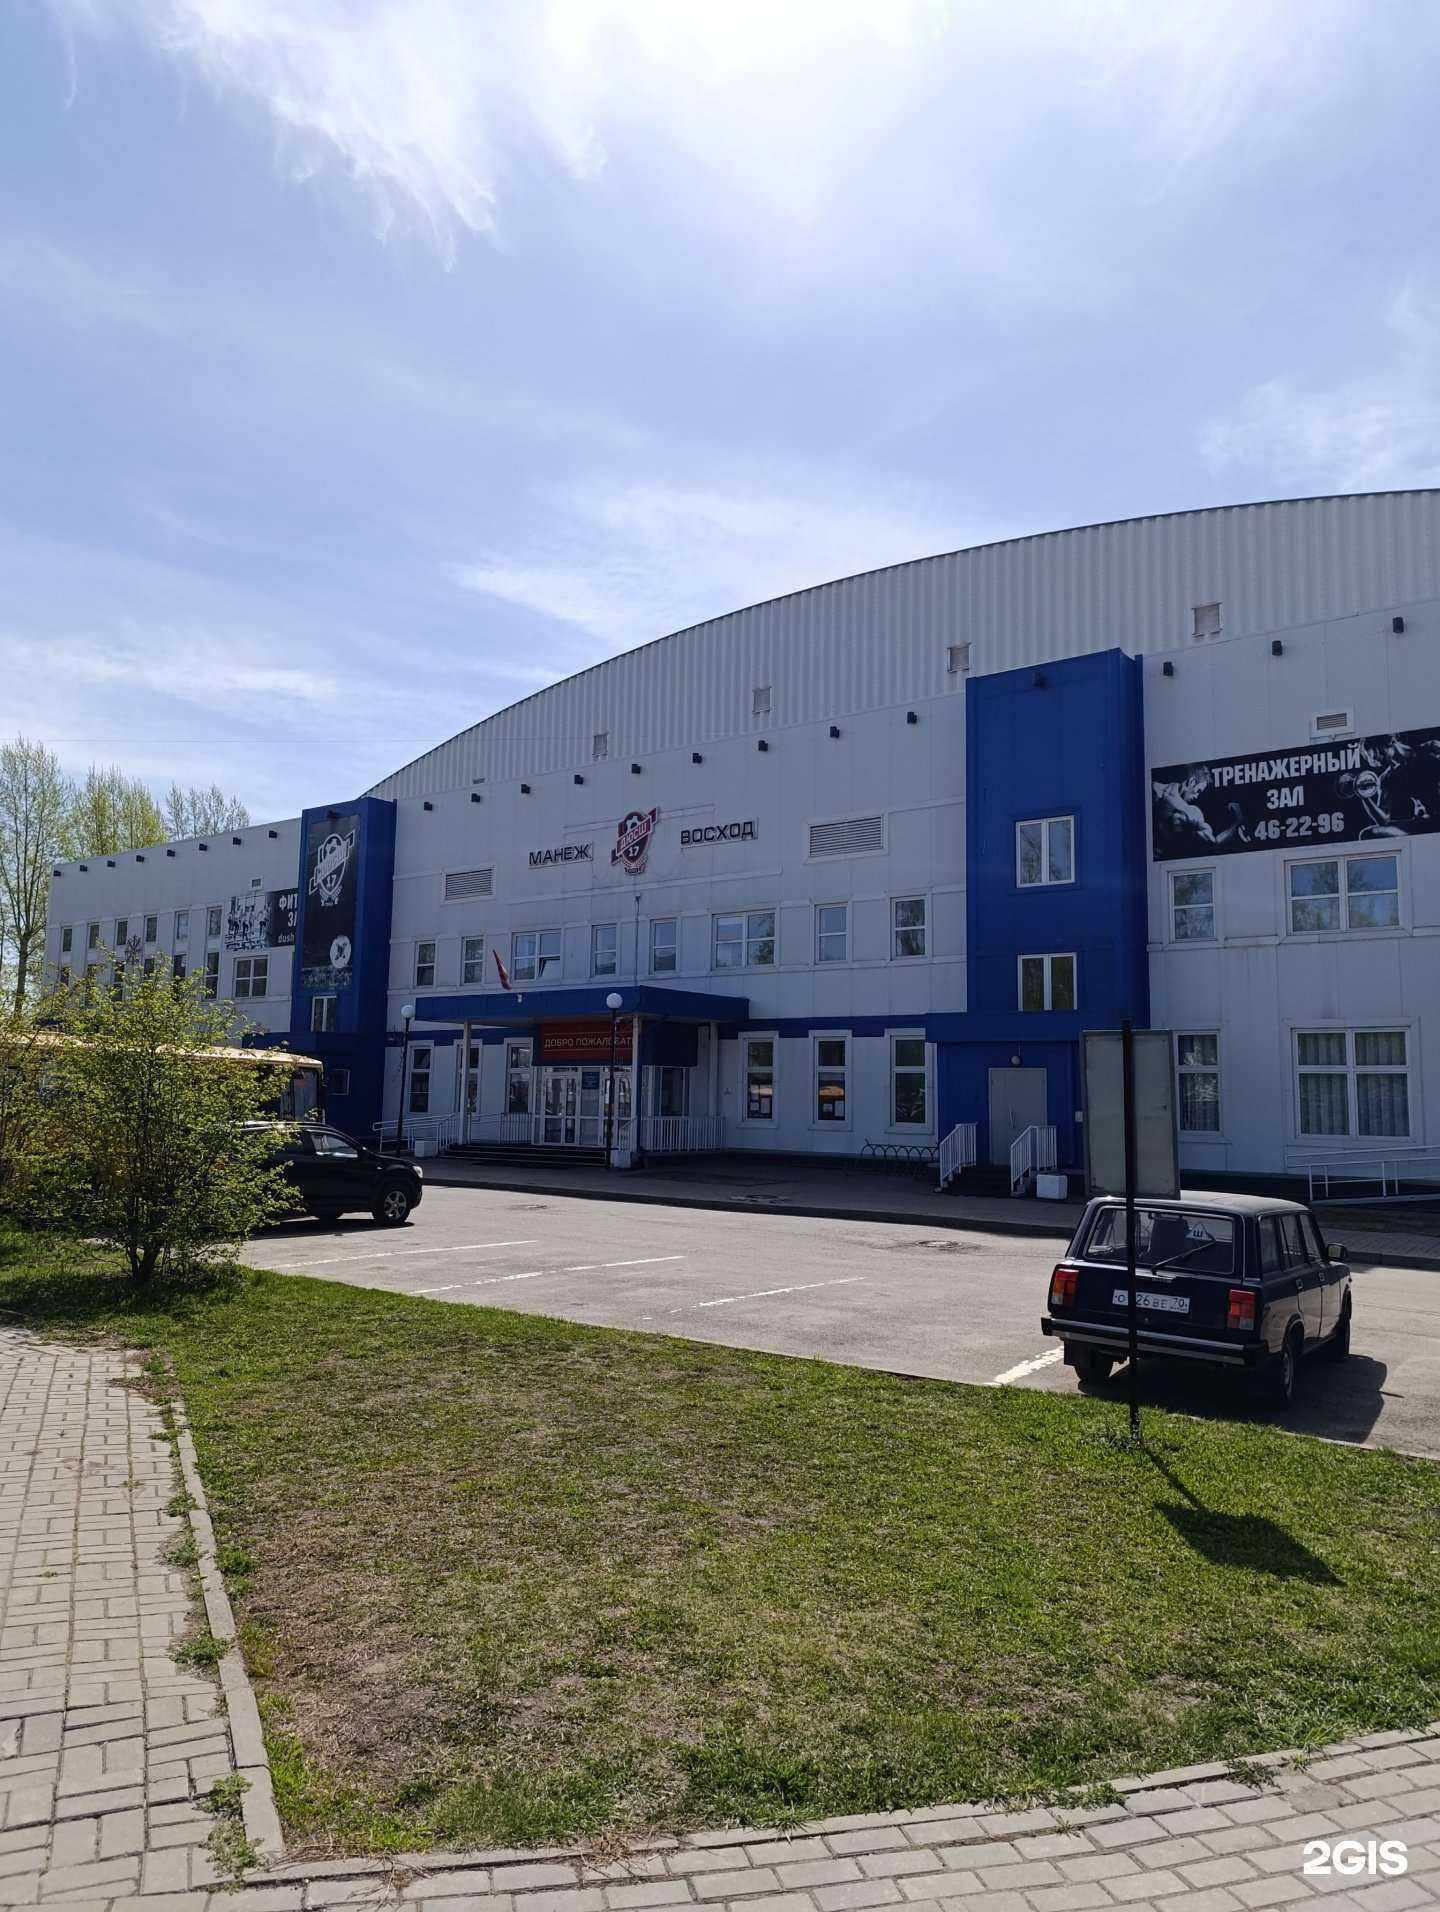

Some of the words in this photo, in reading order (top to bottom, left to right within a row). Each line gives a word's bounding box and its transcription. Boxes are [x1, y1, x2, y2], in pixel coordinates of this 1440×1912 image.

[1212, 743, 1361, 788] ТРЕНАЖЕРНЫЙ
[1267, 786, 1304, 810] ЗАЛ
[681, 821, 754, 845] ВОСХОД
[1255, 812, 1345, 841] 46-22-96
[529, 843, 592, 866] МАНЕЖ
[629, 846, 639, 857] 17
[544, 1038, 574, 1048] ДОБРО
